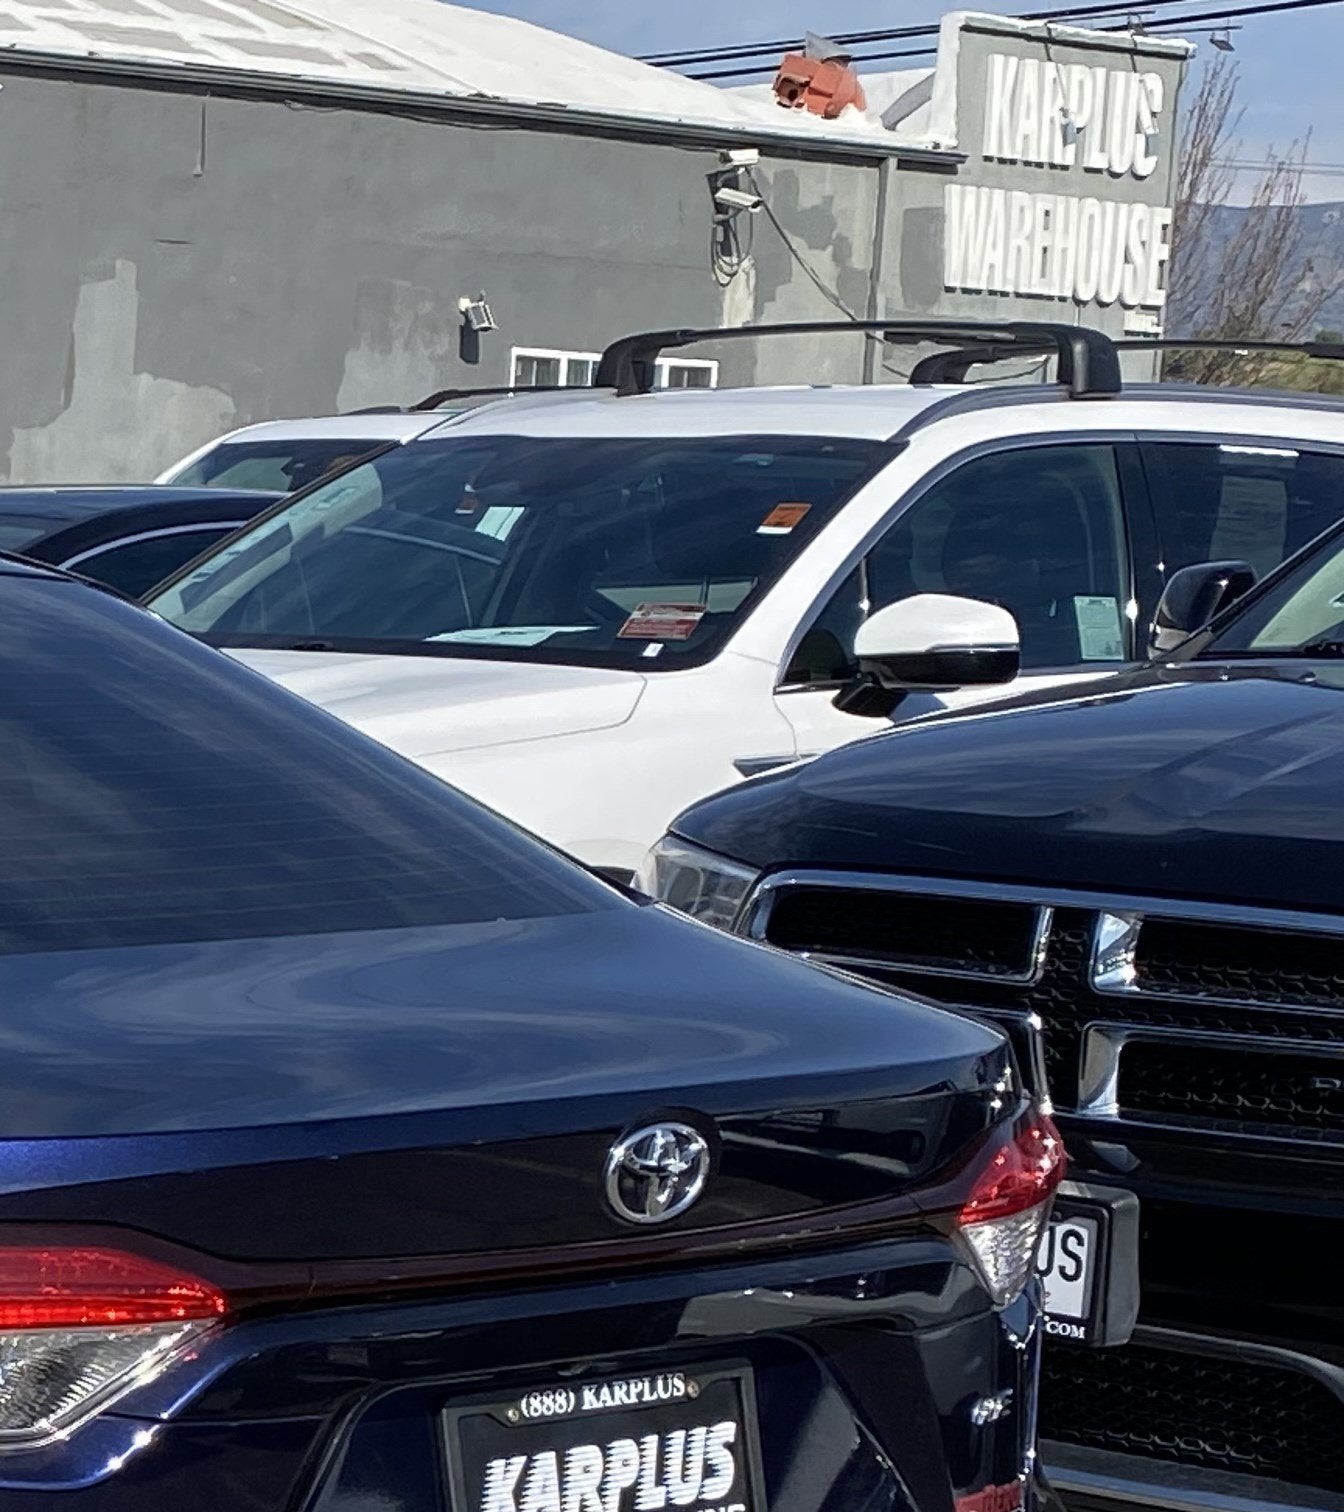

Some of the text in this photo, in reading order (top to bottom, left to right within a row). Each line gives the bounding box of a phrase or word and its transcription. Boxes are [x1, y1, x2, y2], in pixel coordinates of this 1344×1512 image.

[983, 53, 1166, 176] KARPLUS
[943, 183, 1173, 307] WAREHOUSE
[521, 1373, 687, 1418] (888) KARPLUS
